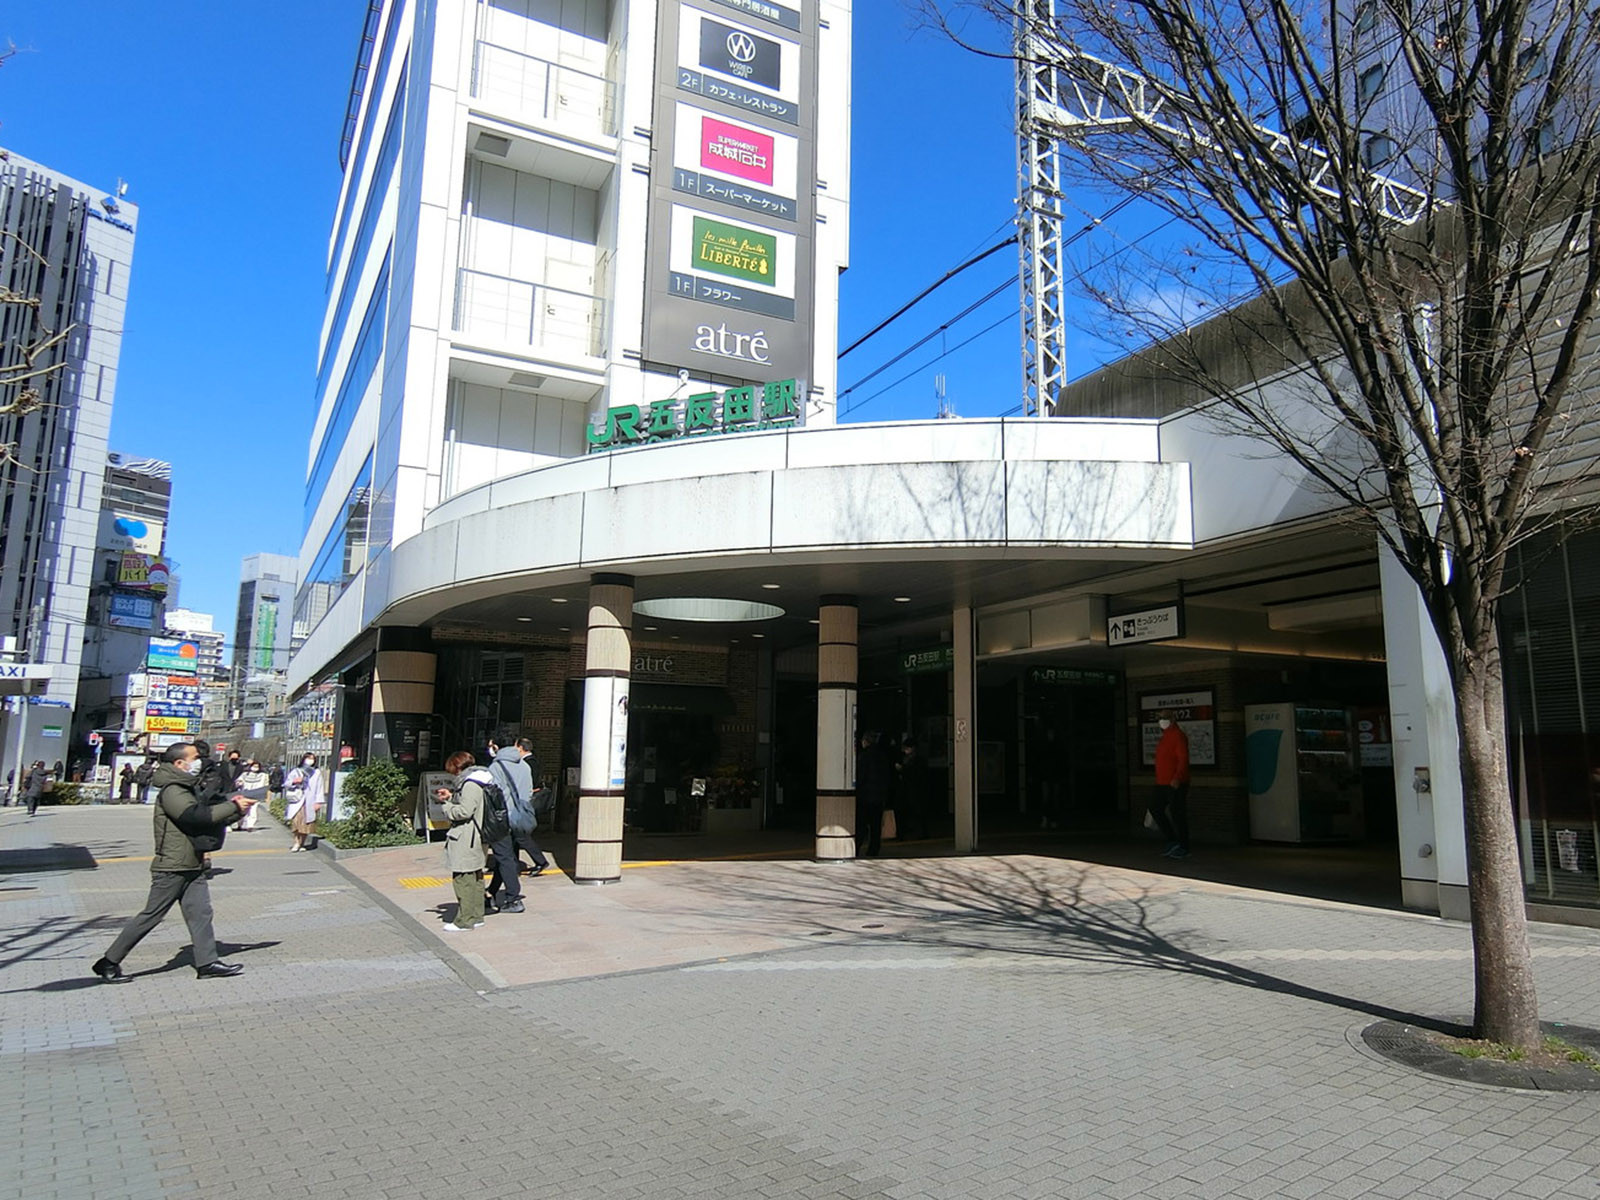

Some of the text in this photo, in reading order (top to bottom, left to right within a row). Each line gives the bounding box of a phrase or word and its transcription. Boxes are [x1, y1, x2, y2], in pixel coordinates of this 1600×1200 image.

[728, 60, 753, 74] WIRED
[681, 73, 699, 89] 2F
[709, 84, 788, 115] カフェ・レストラン
[717, 135, 759, 152] SUPERMARKET
[679, 173, 695, 189] 1F
[706, 182, 788, 212] スーパーマーケット
[675, 277, 691, 292] 1F
[702, 286, 742, 301] フラワー
[695, 322, 769, 362] atré
[634, 655, 673, 672] atré
